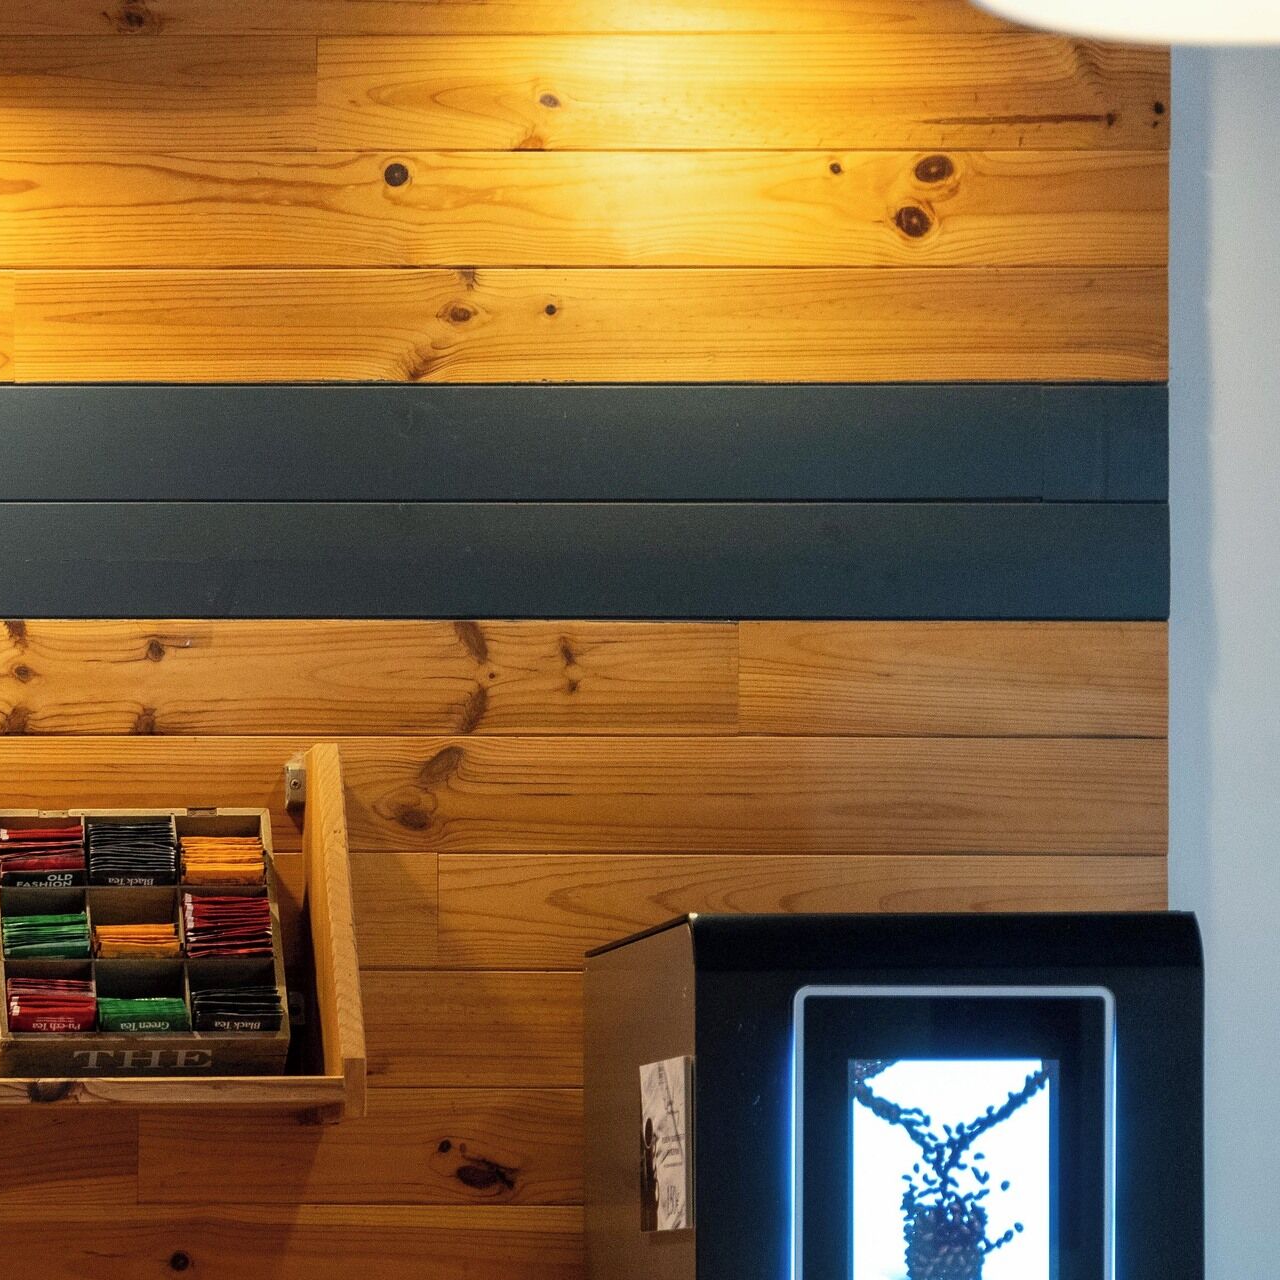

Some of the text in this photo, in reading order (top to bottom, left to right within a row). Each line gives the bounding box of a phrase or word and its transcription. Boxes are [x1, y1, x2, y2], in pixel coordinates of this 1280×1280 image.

[47, 873, 73, 882] OLD
[108, 877, 154, 887] Black Tea
[32, 1022, 48, 1030] Tea
[120, 1021, 170, 1032] Green Tea
[214, 1020, 262, 1030] Black Tea
[73, 1050, 212, 1068] THE
